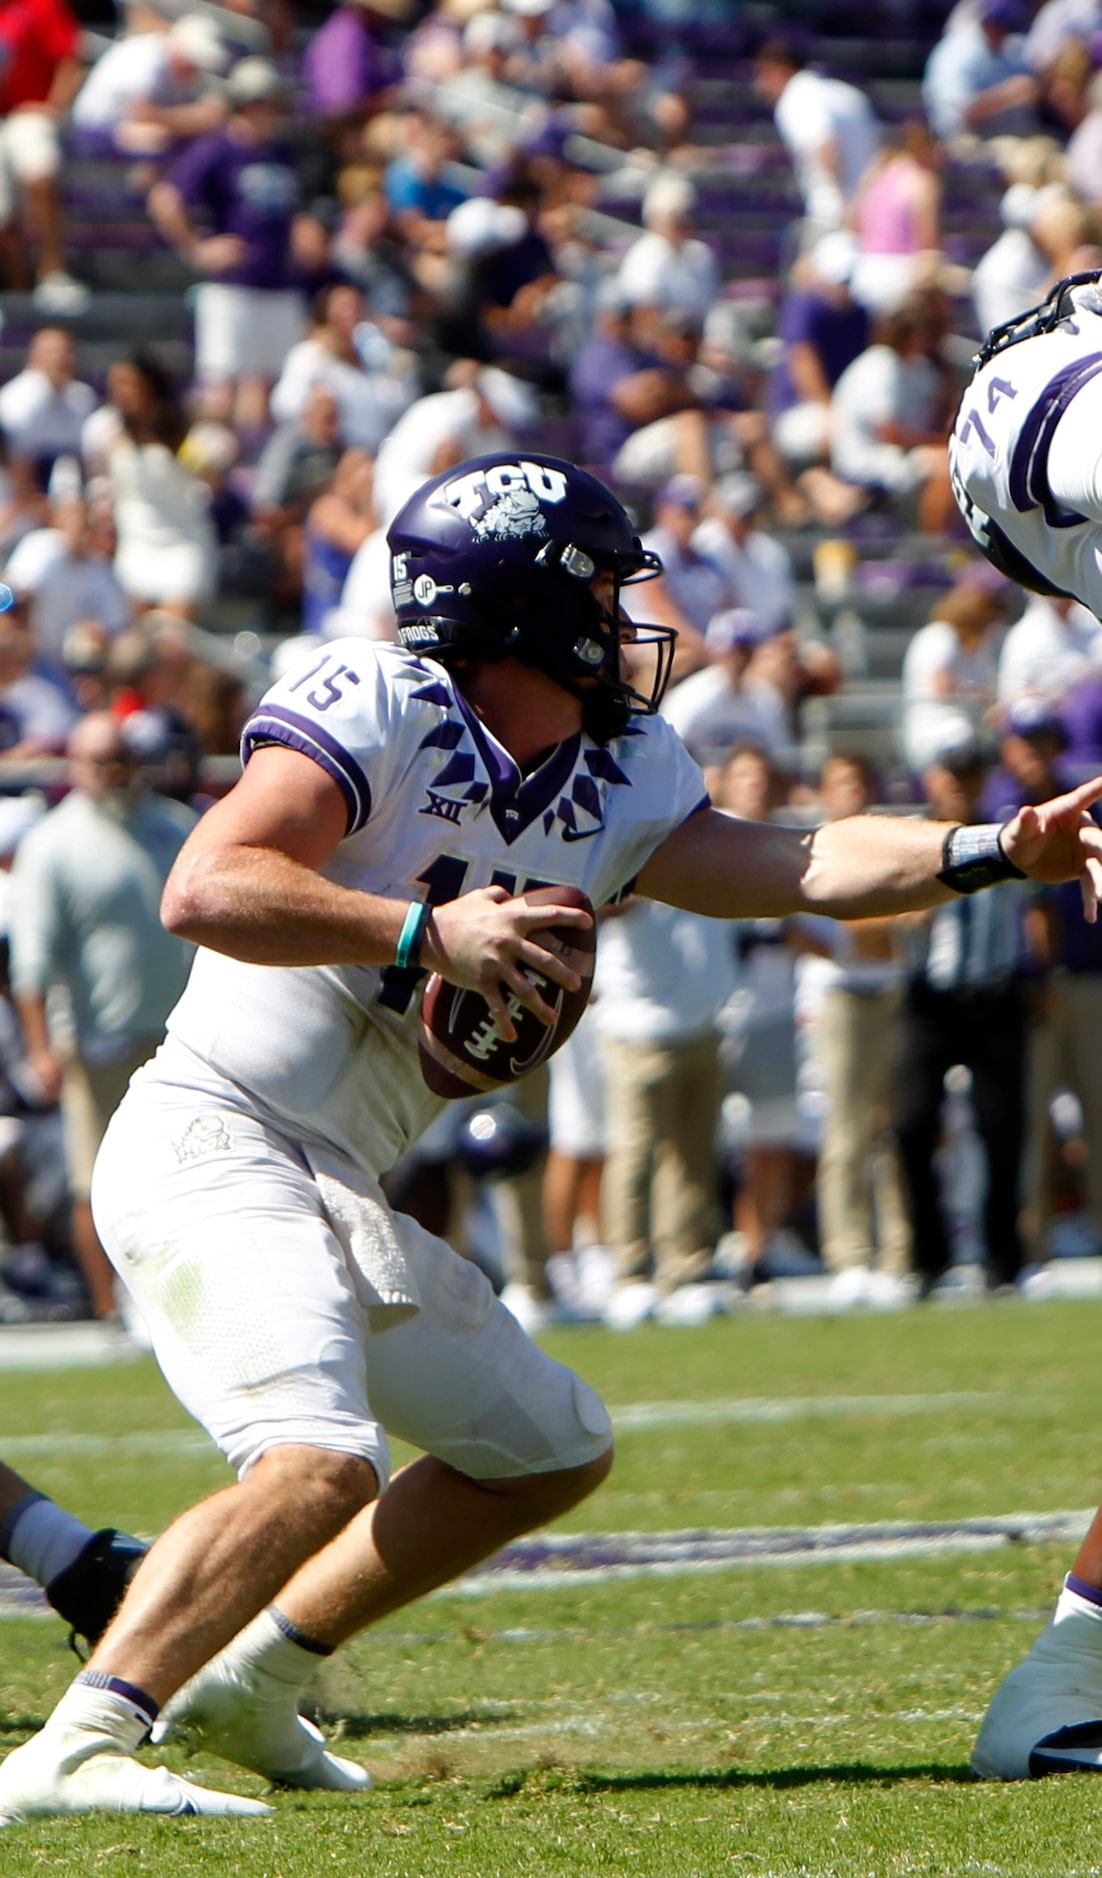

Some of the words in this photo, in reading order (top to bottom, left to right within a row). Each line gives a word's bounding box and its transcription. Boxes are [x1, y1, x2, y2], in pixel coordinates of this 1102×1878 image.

[959, 376, 1018, 459] 74
[443, 460, 568, 527] TCU
[418, 580, 433, 599] JP
[400, 625, 440, 644] FROGS
[288, 654, 361, 712] 15
[418, 789, 469, 826] XII
